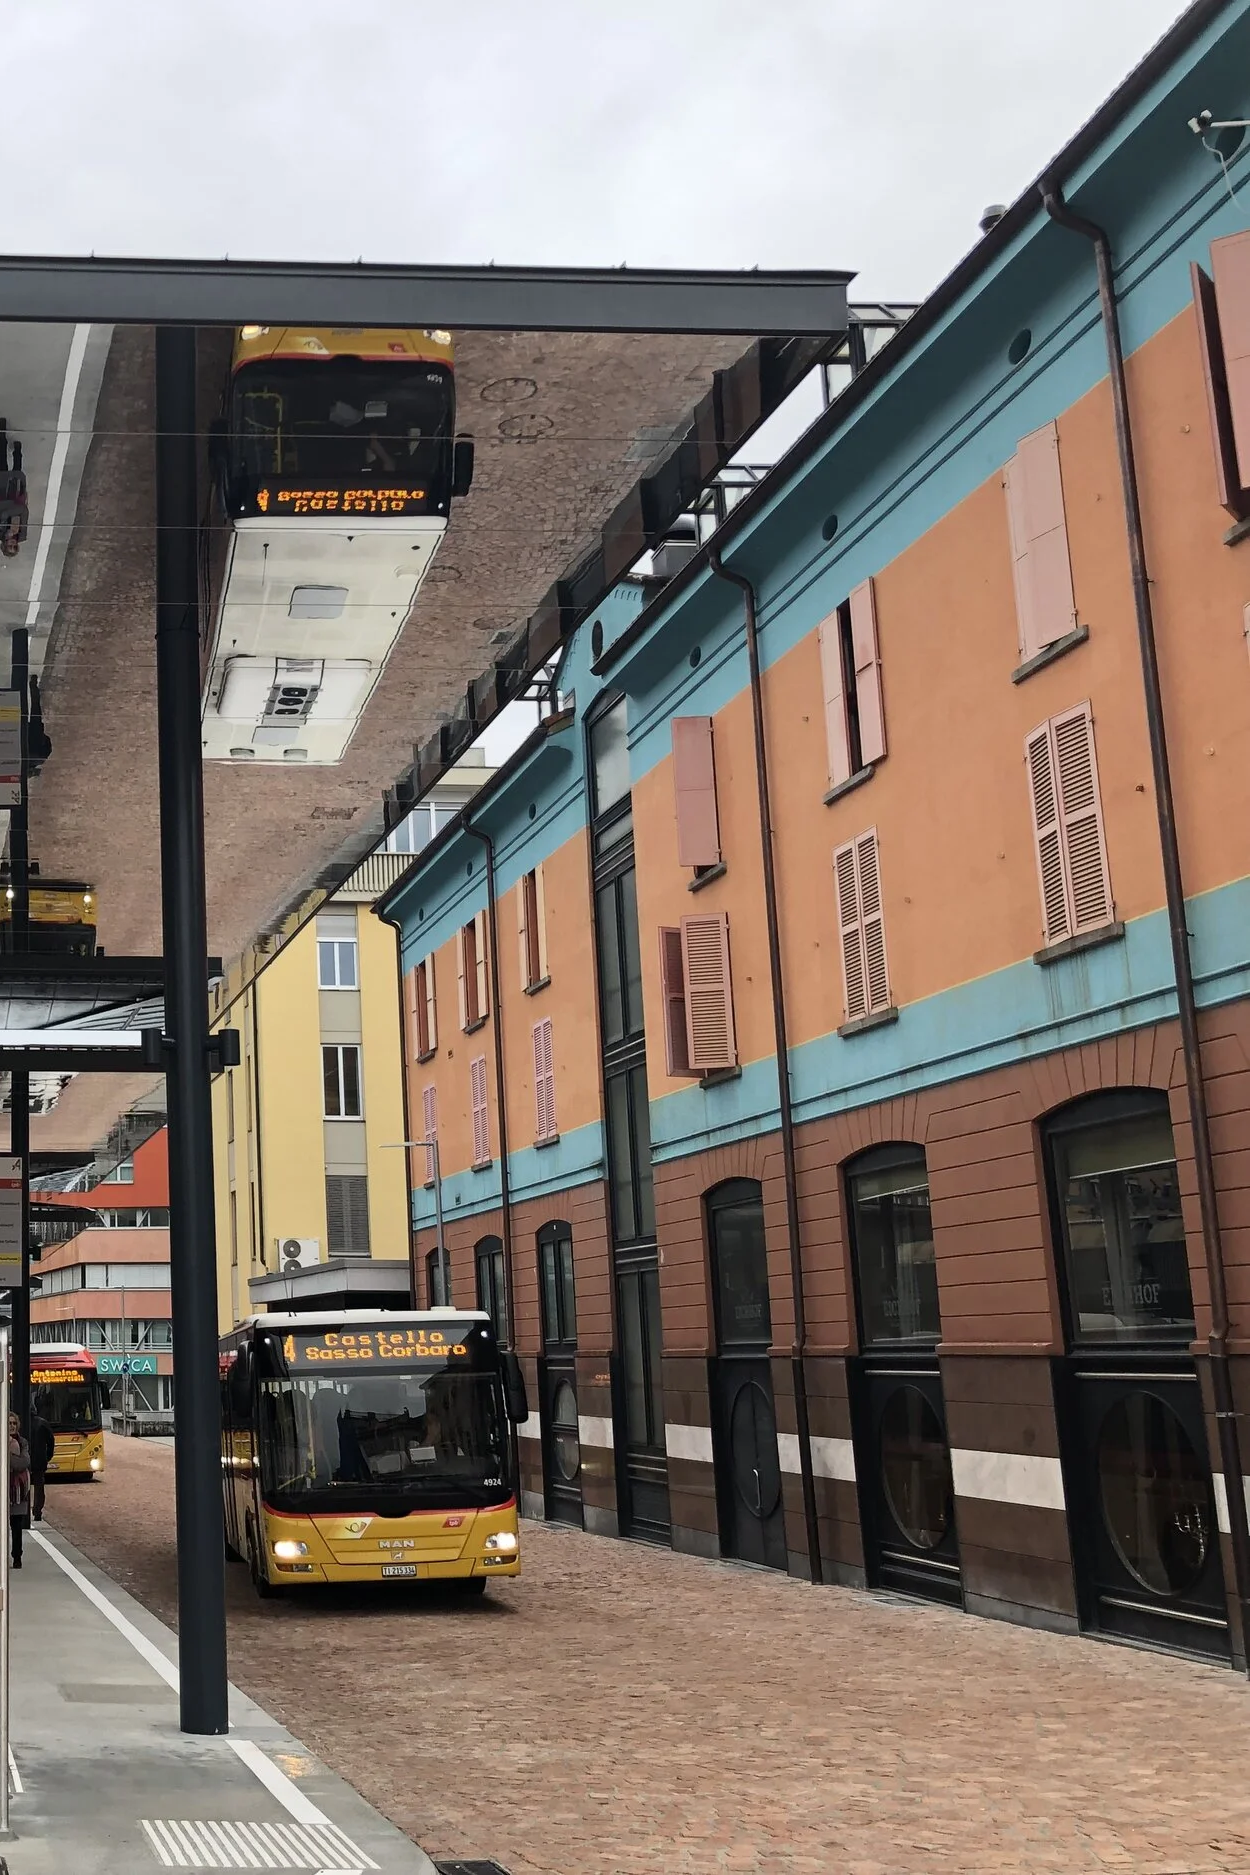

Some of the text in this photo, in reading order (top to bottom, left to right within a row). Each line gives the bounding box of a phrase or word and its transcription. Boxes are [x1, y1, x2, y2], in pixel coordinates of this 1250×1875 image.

[324, 1329, 444, 1347] Castello
[283, 1333, 296, 1363] 4
[305, 1343, 467, 1361] Sasso Corbaro
[483, 1478, 502, 1487] 4924
[378, 1540, 415, 1549] MAN
